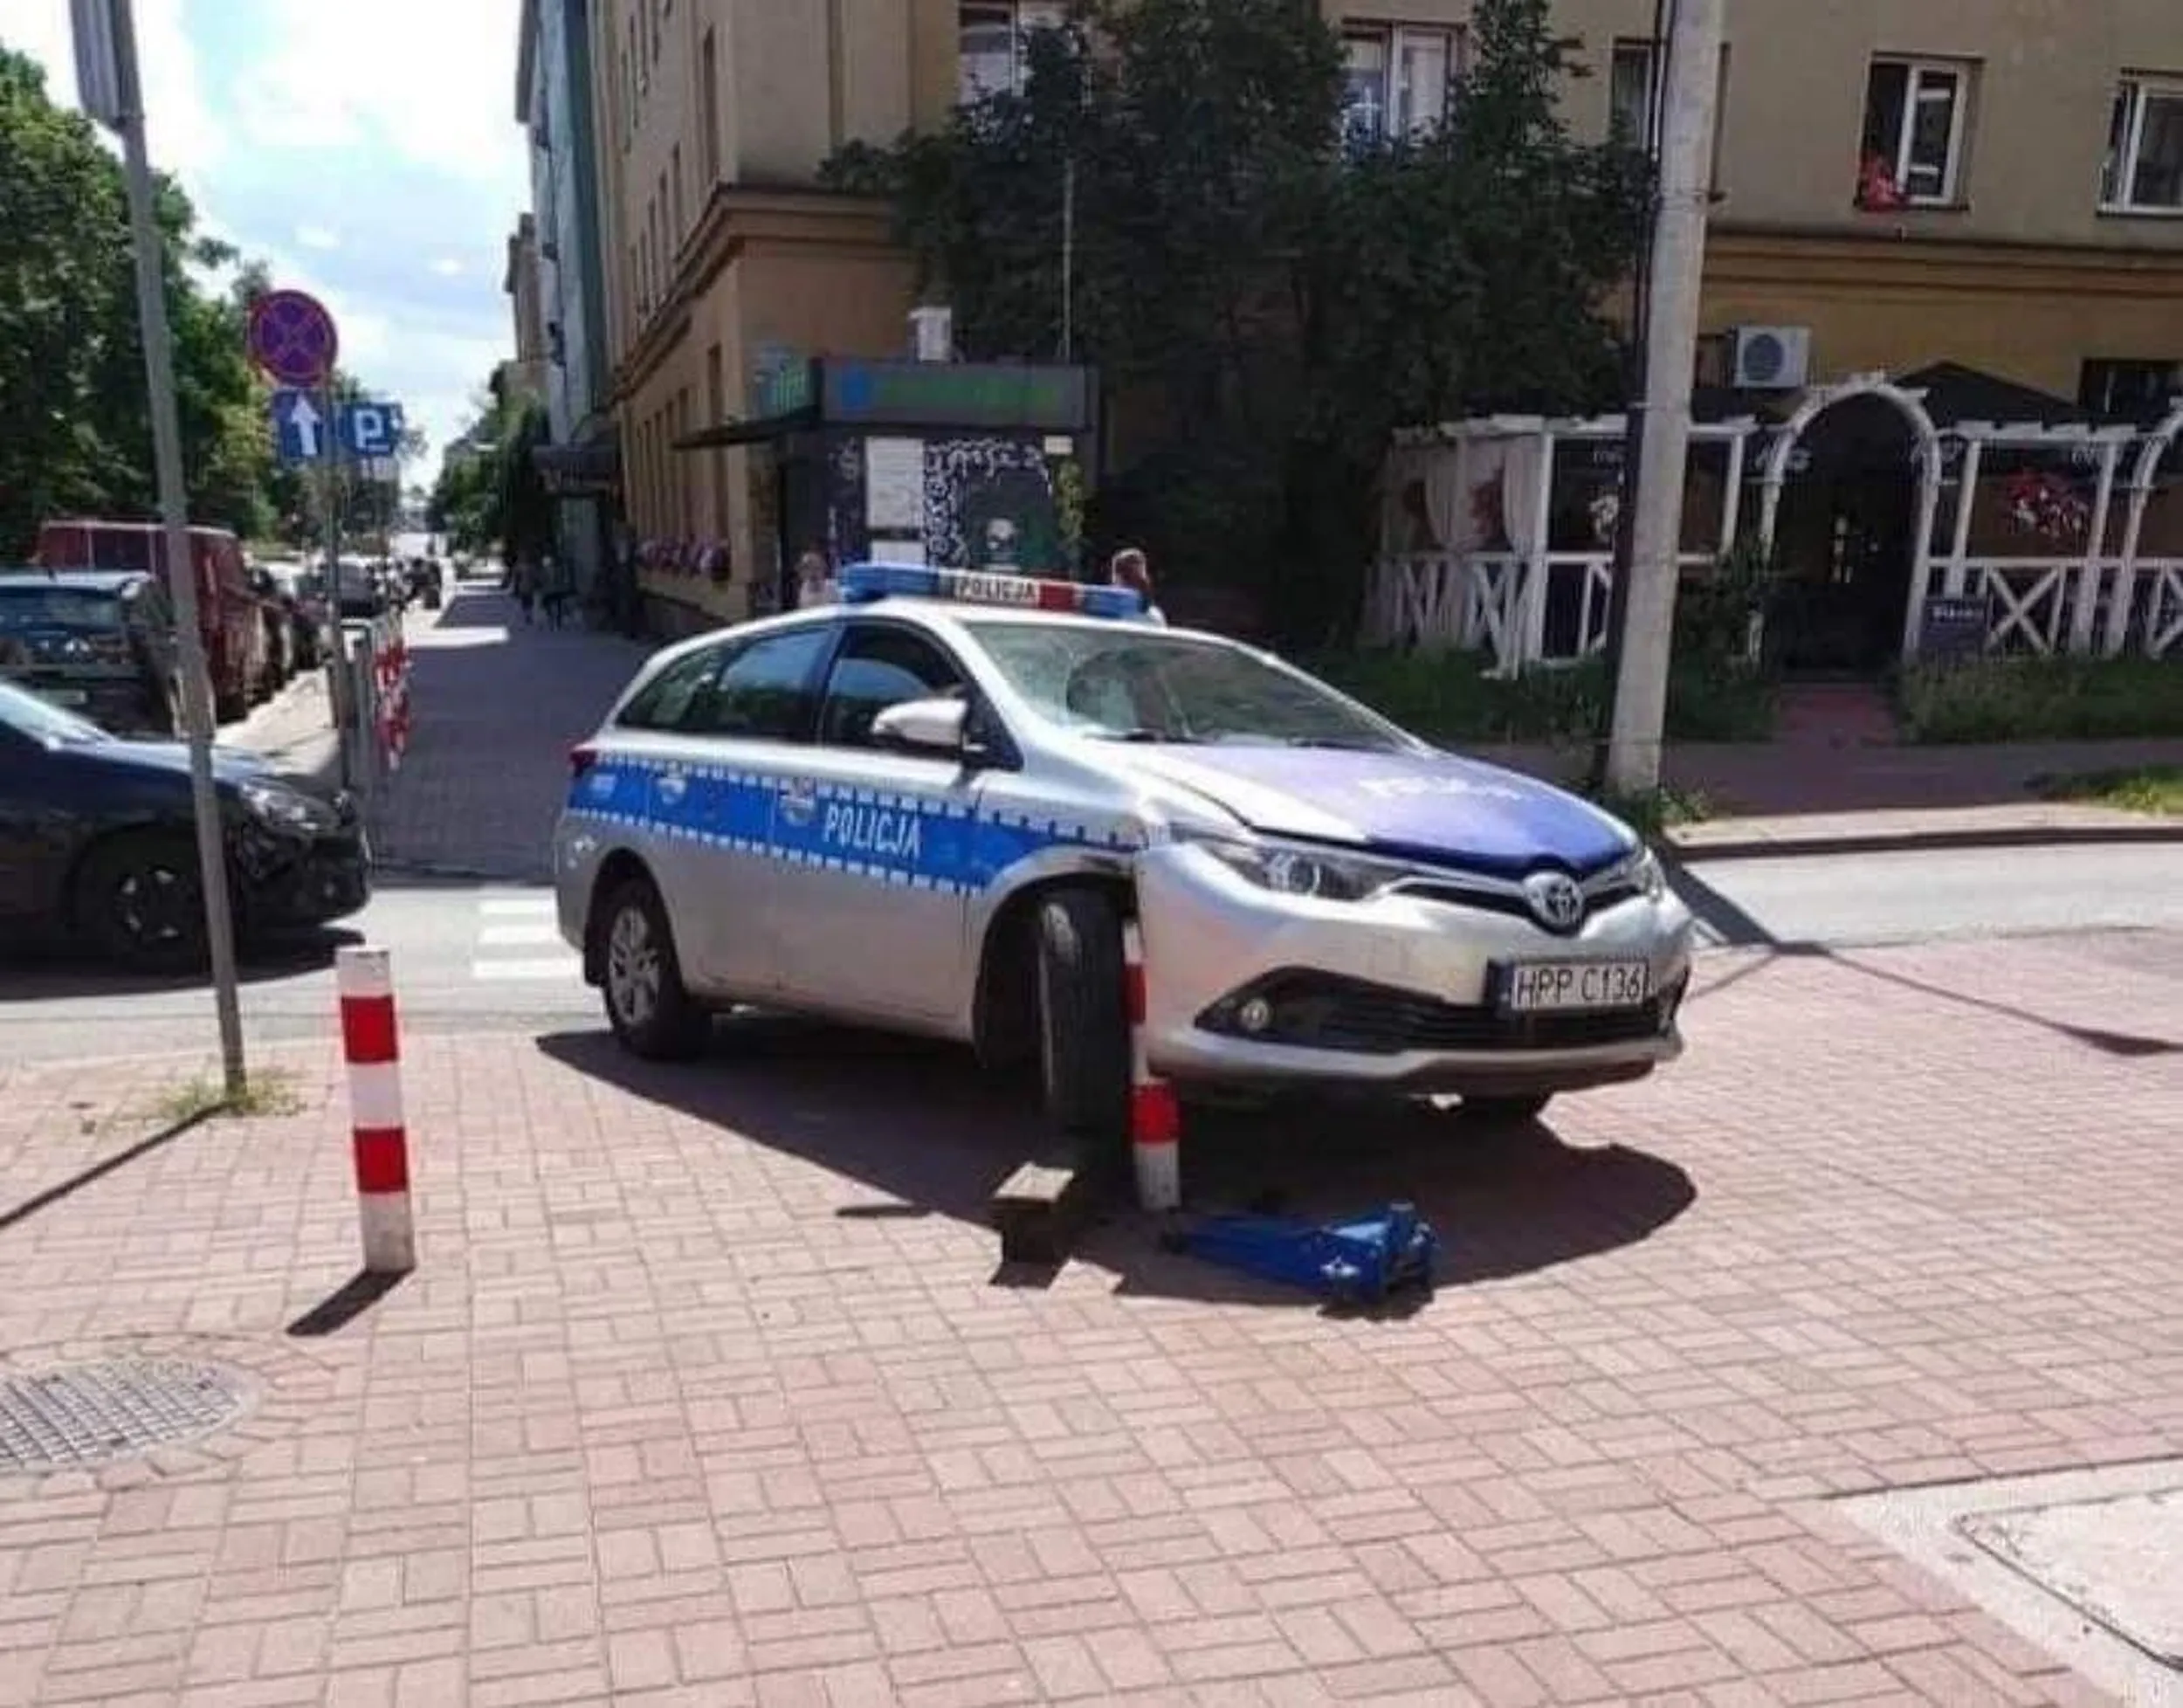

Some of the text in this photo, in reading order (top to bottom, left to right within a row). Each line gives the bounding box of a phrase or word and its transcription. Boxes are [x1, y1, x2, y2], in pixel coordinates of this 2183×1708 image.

[959, 576, 1036, 603] POLICJA
[823, 802, 920, 858] POLICJA
[1517, 967, 1573, 1006] HPP
